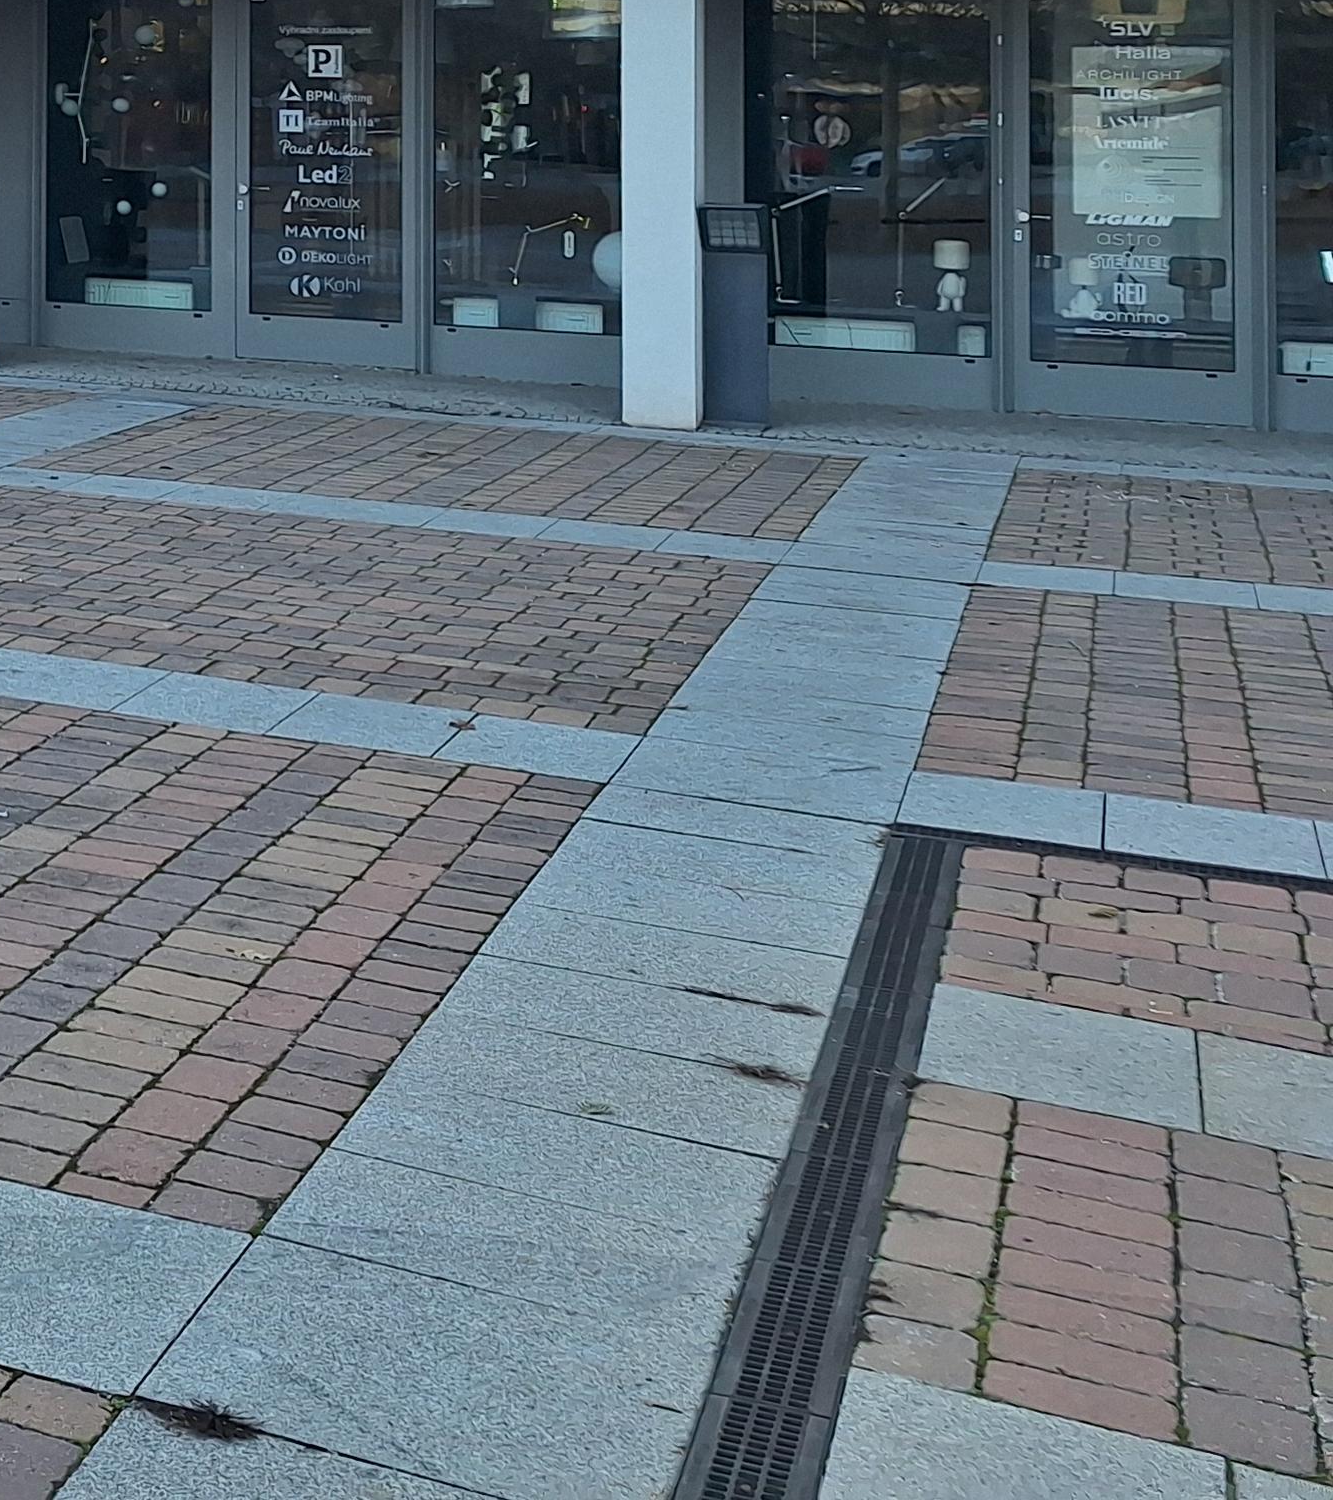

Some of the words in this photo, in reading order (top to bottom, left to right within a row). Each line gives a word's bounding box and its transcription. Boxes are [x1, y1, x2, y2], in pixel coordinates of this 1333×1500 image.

[1109, 21, 1155, 37] SLV
[1115, 45, 1171, 60] Halla
[1076, 69, 1182, 81] ARCHILIGHT
[298, 164, 352, 185] Led2
[299, 196, 361, 209] novalux
[1096, 232, 1162, 247] astro
[301, 251, 374, 265] DEKOLIGHT
[1088, 253, 1169, 272] STEINEL
[324, 276, 361, 293] Kohl
[1113, 282, 1147, 305] RED
